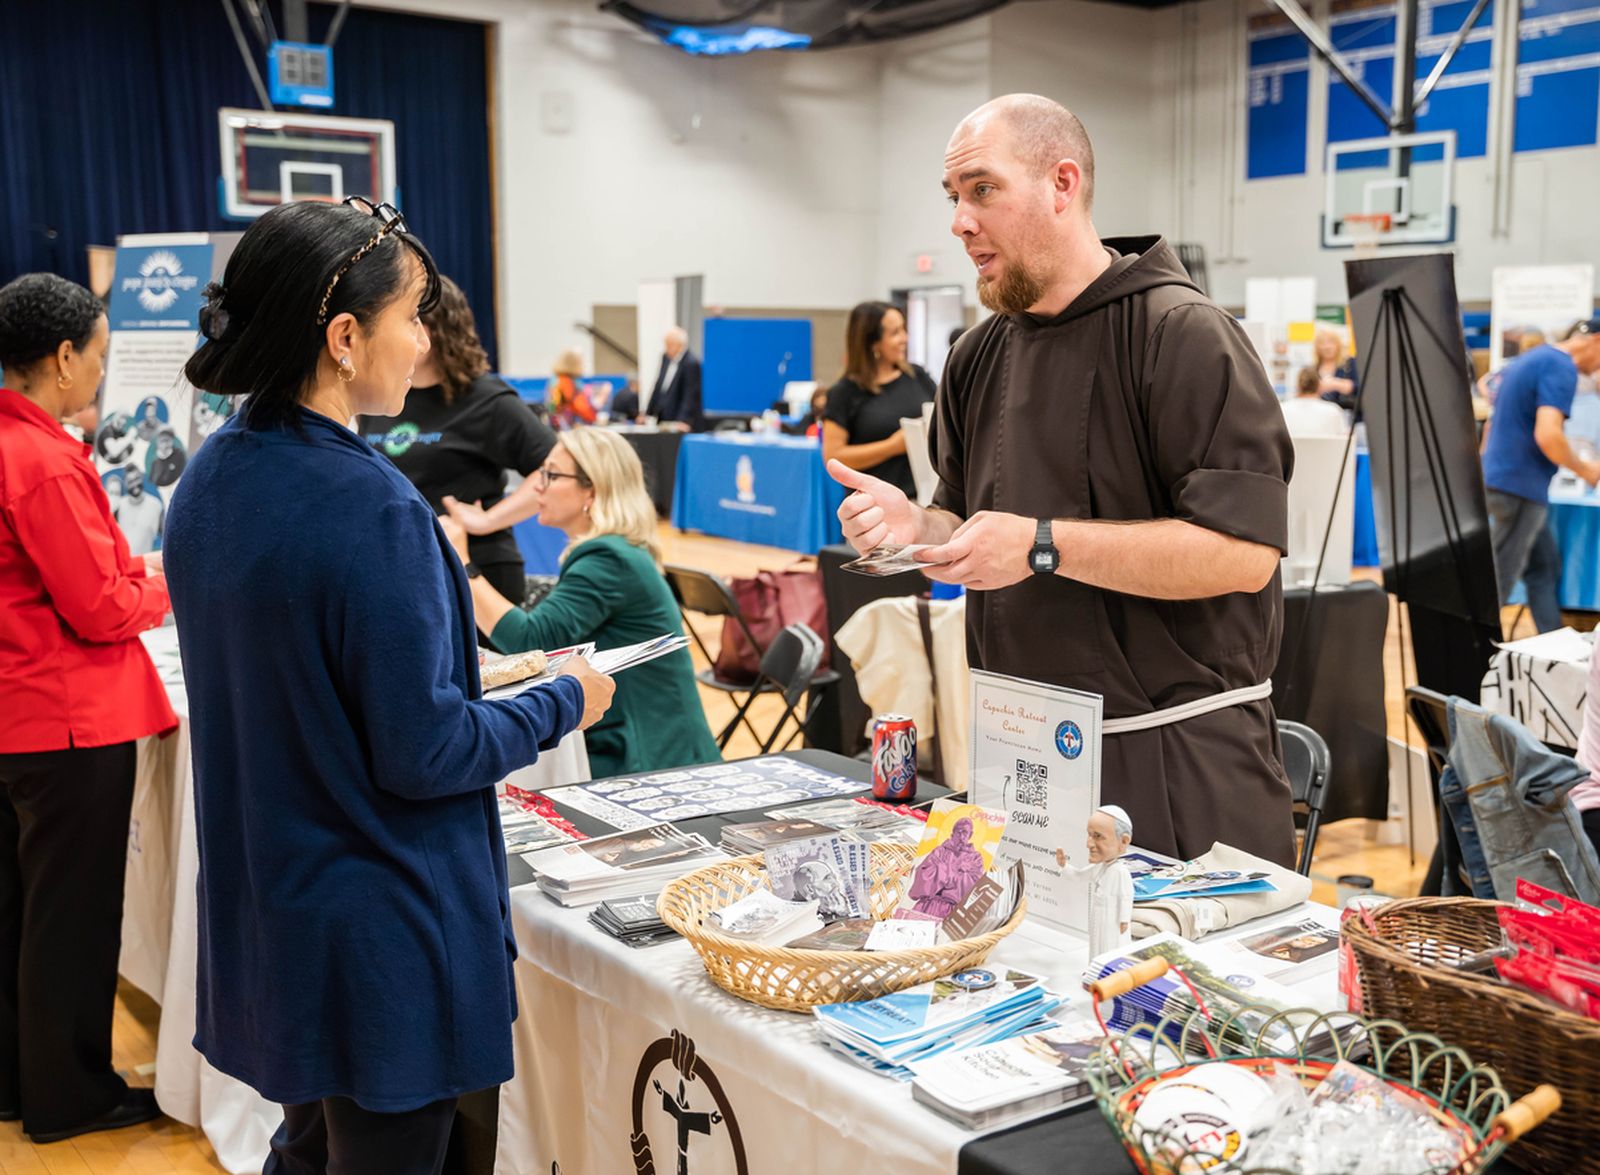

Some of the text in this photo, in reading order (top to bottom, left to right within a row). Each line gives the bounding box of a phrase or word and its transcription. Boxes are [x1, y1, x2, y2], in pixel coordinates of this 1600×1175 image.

[982, 699, 1047, 724] Capuchin Retreat
[1002, 719, 1026, 736] Center
[874, 727, 916, 783] Faygo
[890, 764, 916, 793] Cola
[1012, 810, 1050, 828] SCAN ME
